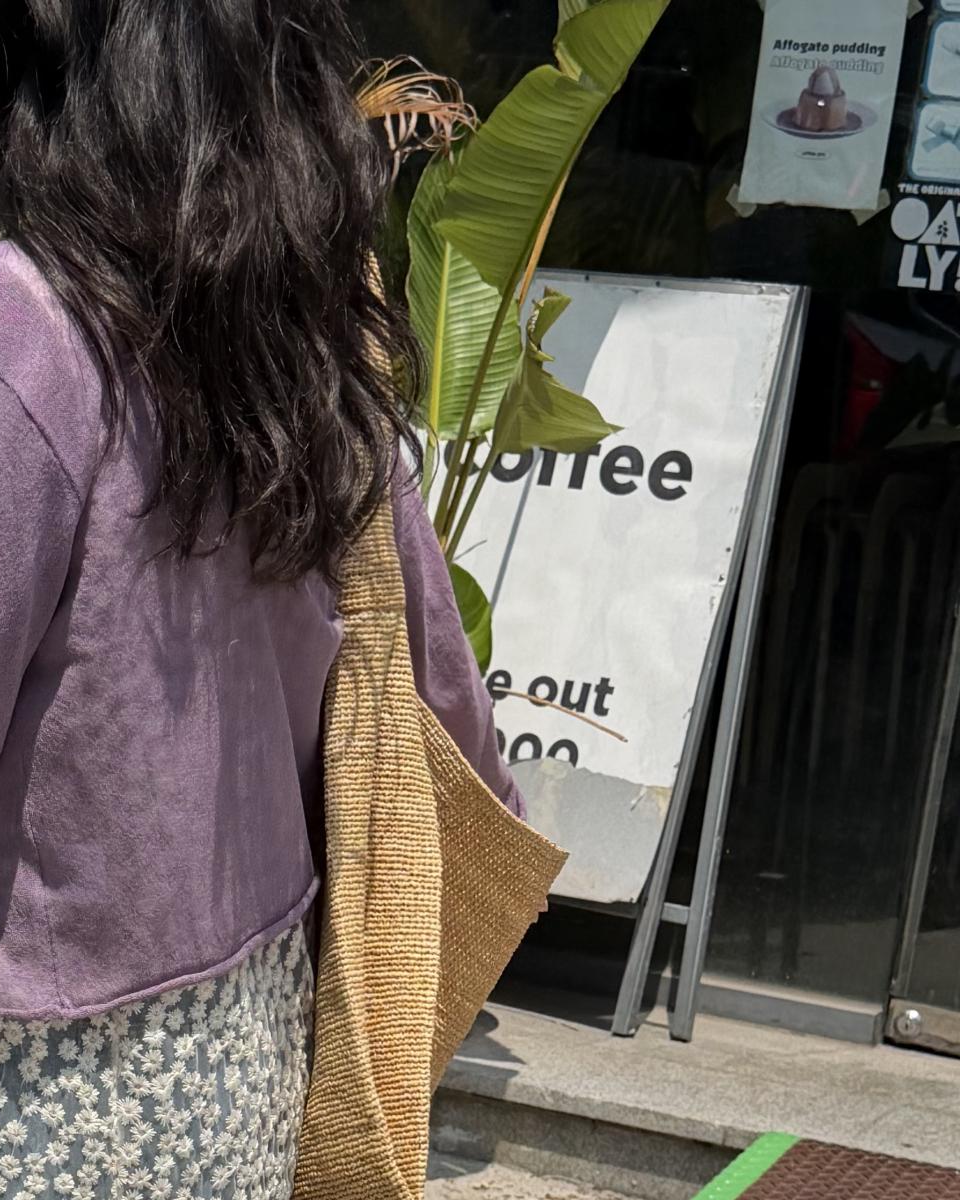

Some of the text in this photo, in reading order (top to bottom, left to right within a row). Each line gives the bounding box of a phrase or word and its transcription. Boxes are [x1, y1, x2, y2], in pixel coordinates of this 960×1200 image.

[773, 39, 887, 57] Affogato pudding
[898, 183, 919, 194] THE
[891, 197, 960, 246] OA
[528, 675, 615, 717] out
